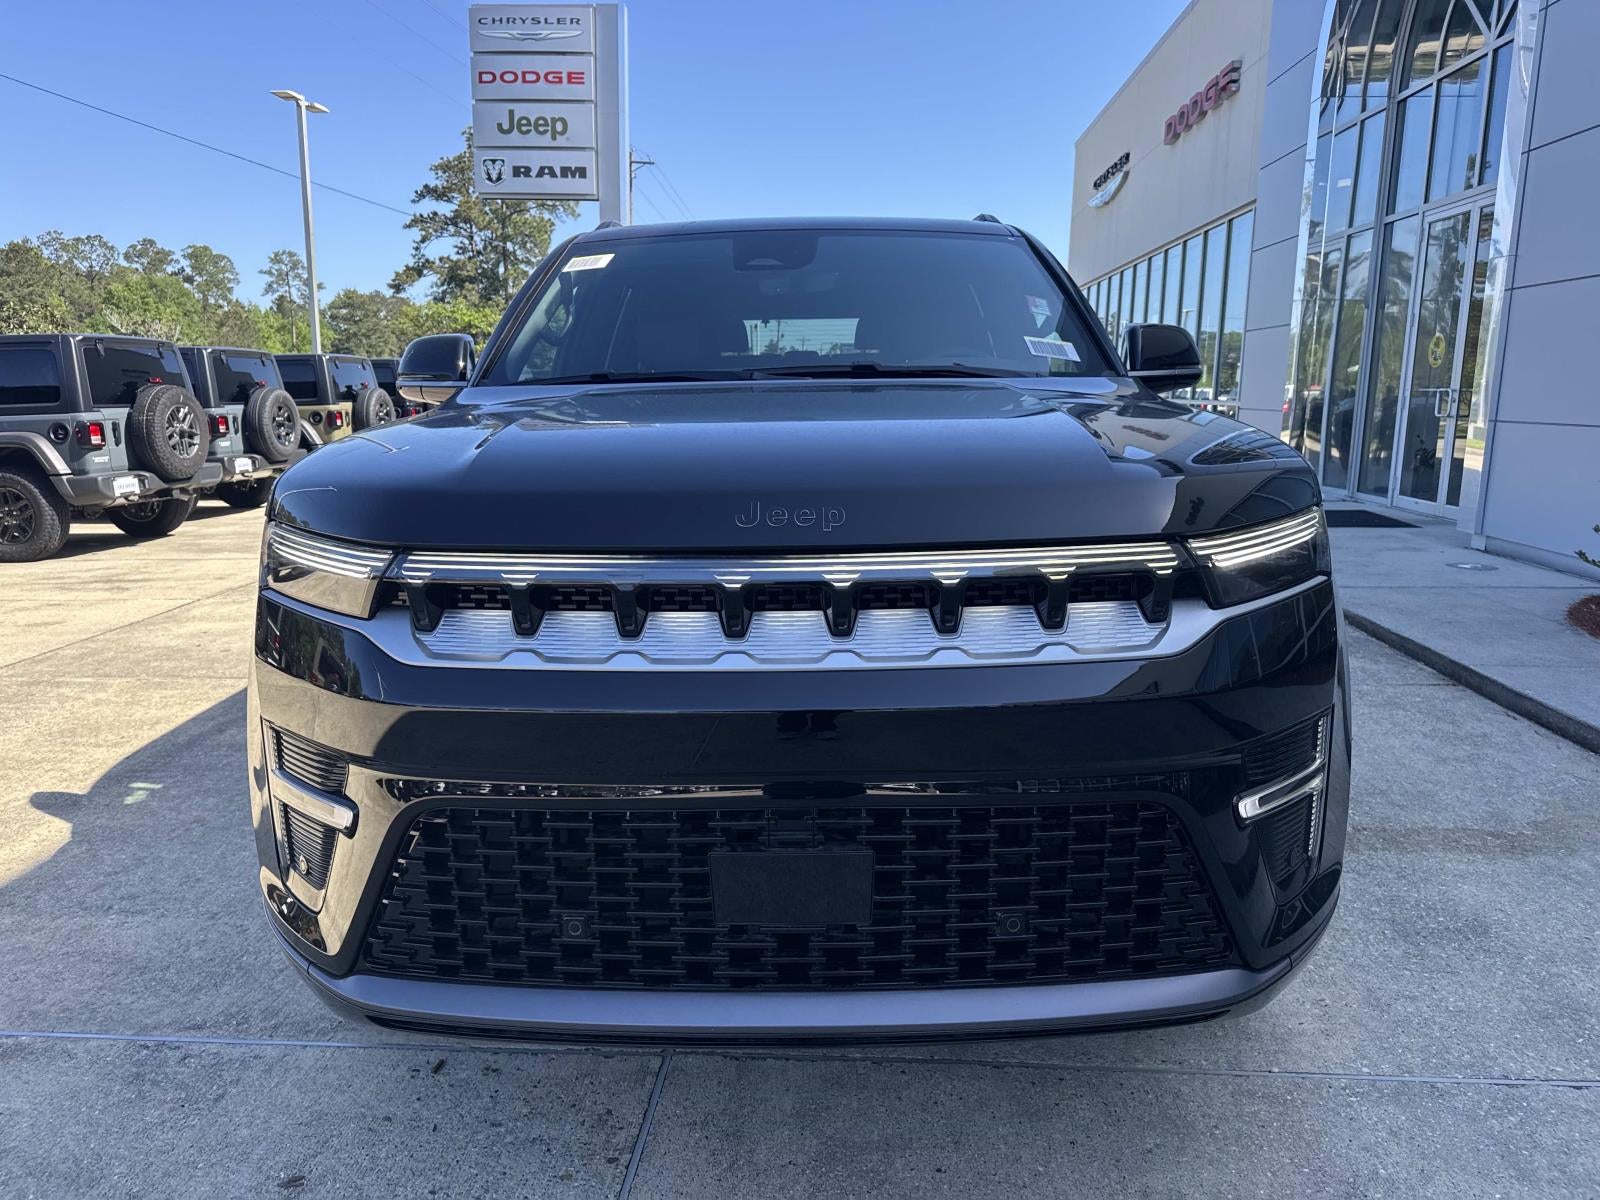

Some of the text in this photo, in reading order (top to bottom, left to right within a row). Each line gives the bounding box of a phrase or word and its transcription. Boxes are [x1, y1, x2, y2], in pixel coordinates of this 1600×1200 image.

[478, 16, 581, 25] CHRYSLER
[478, 71, 585, 85] DODGE
[1163, 60, 1243, 146] DODGE
[496, 109, 569, 141] Jeep
[512, 165, 588, 179] RAM
[734, 499, 846, 532] Jeep
